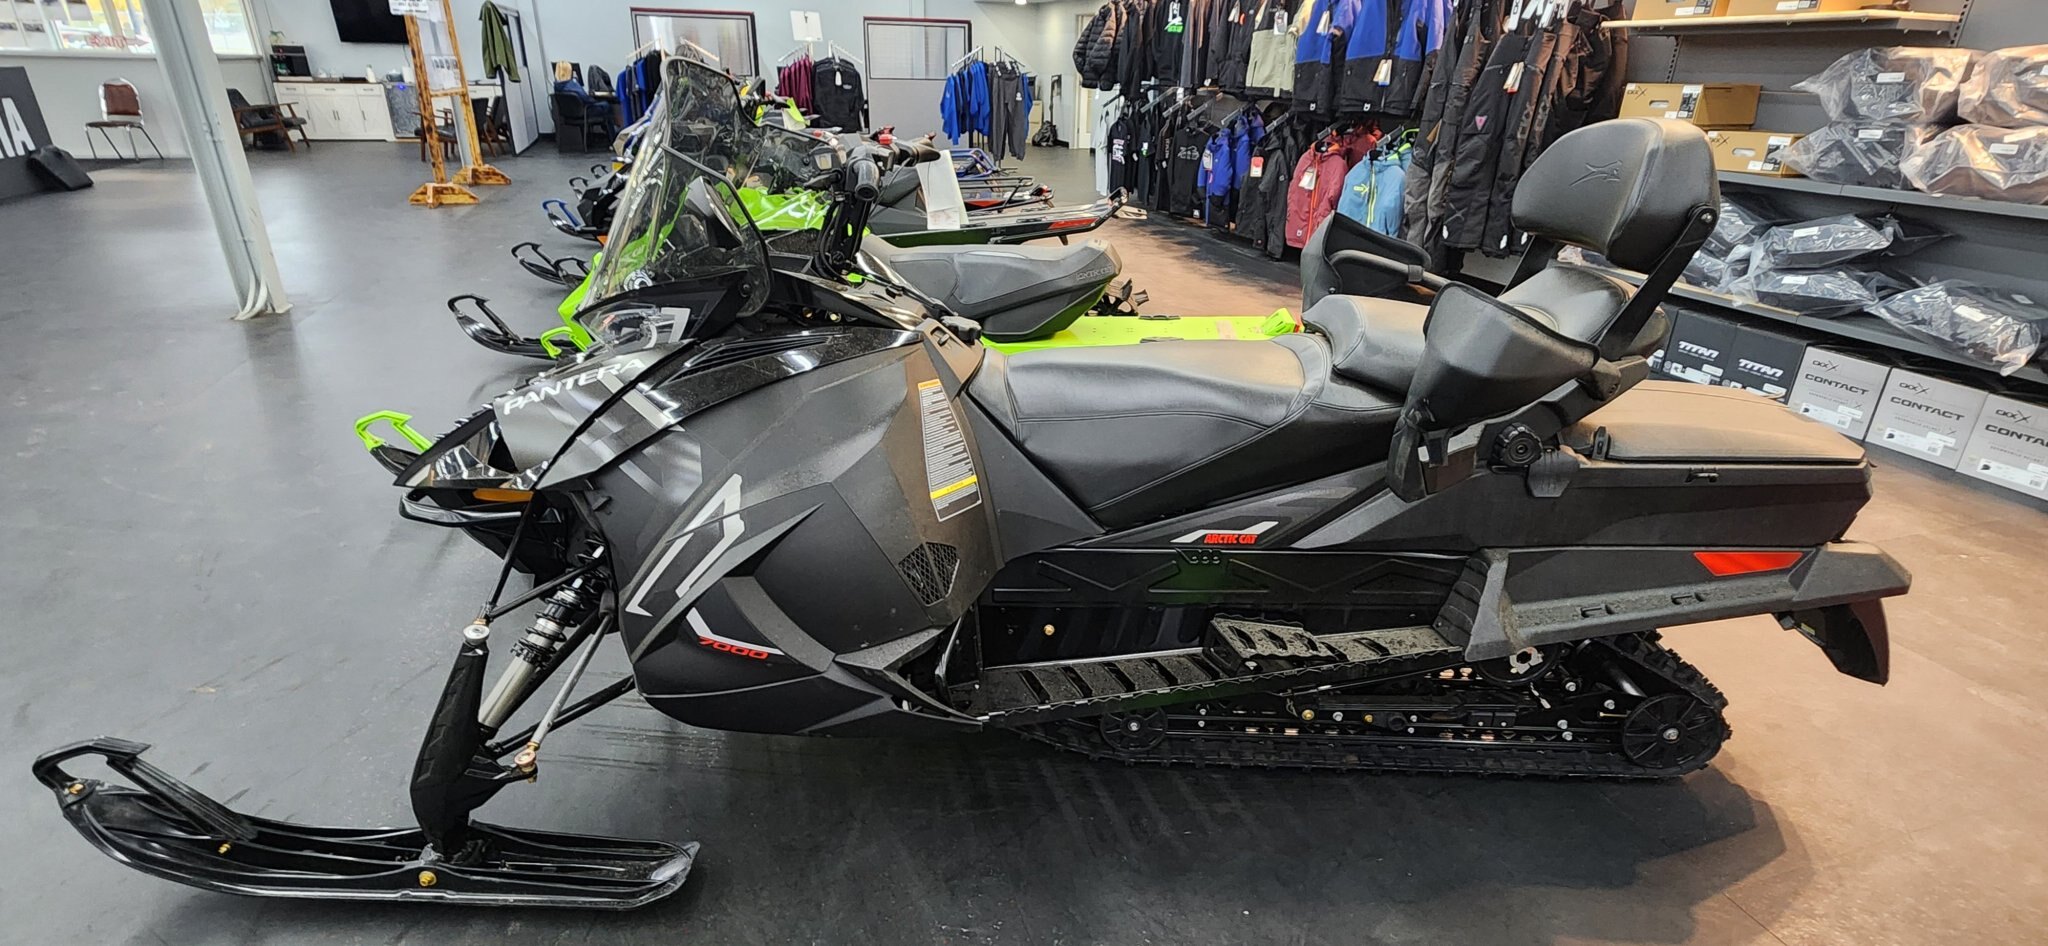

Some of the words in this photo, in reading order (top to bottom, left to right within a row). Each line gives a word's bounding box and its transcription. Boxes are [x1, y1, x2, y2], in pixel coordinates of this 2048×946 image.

[1678, 340, 1720, 358] TITAN
[1738, 358, 1784, 377] TITAN
[503, 358, 646, 415] PANTERA
[1804, 373, 1869, 395] CONTACT
[1890, 396, 1965, 421] CONTACT
[1985, 424, 2048, 447] CONTA
[1203, 533, 1238, 544] ARCTIC
[1238, 533, 1258, 544] CAT
[699, 636, 769, 660] 7000
